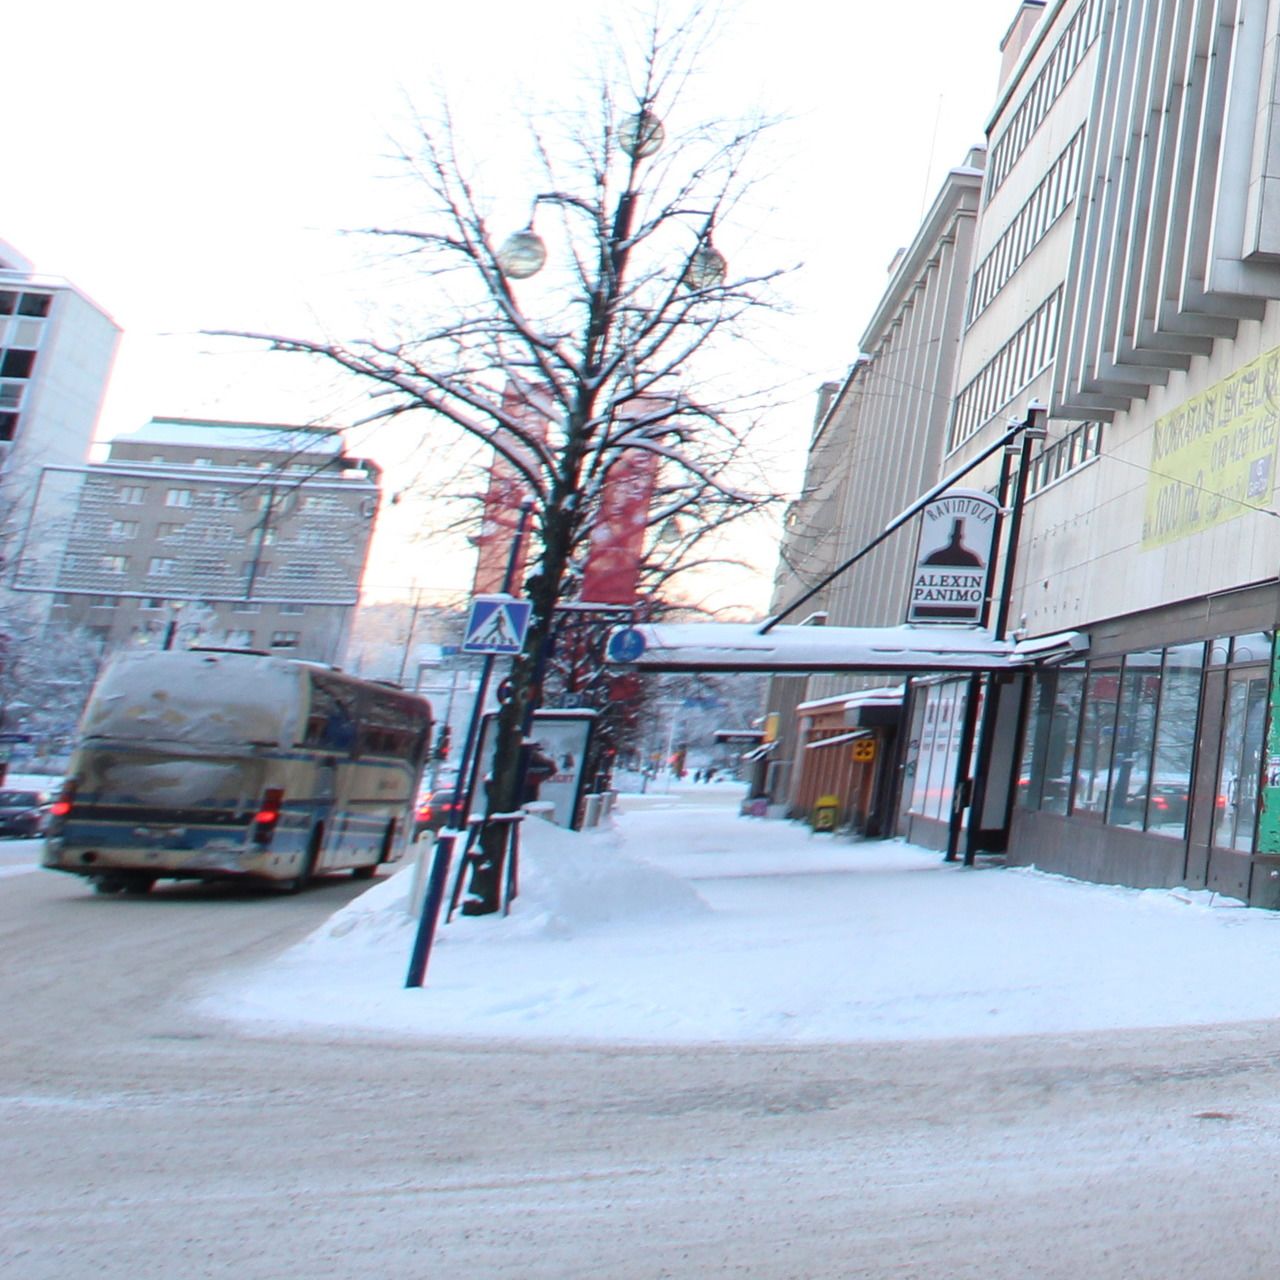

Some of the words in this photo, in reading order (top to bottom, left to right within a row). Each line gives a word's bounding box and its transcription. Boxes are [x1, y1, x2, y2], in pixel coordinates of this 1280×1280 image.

[926, 500, 995, 524] RAVINTOLA
[915, 574, 984, 588] ALEXIN
[913, 588, 982, 602] PANIMO
